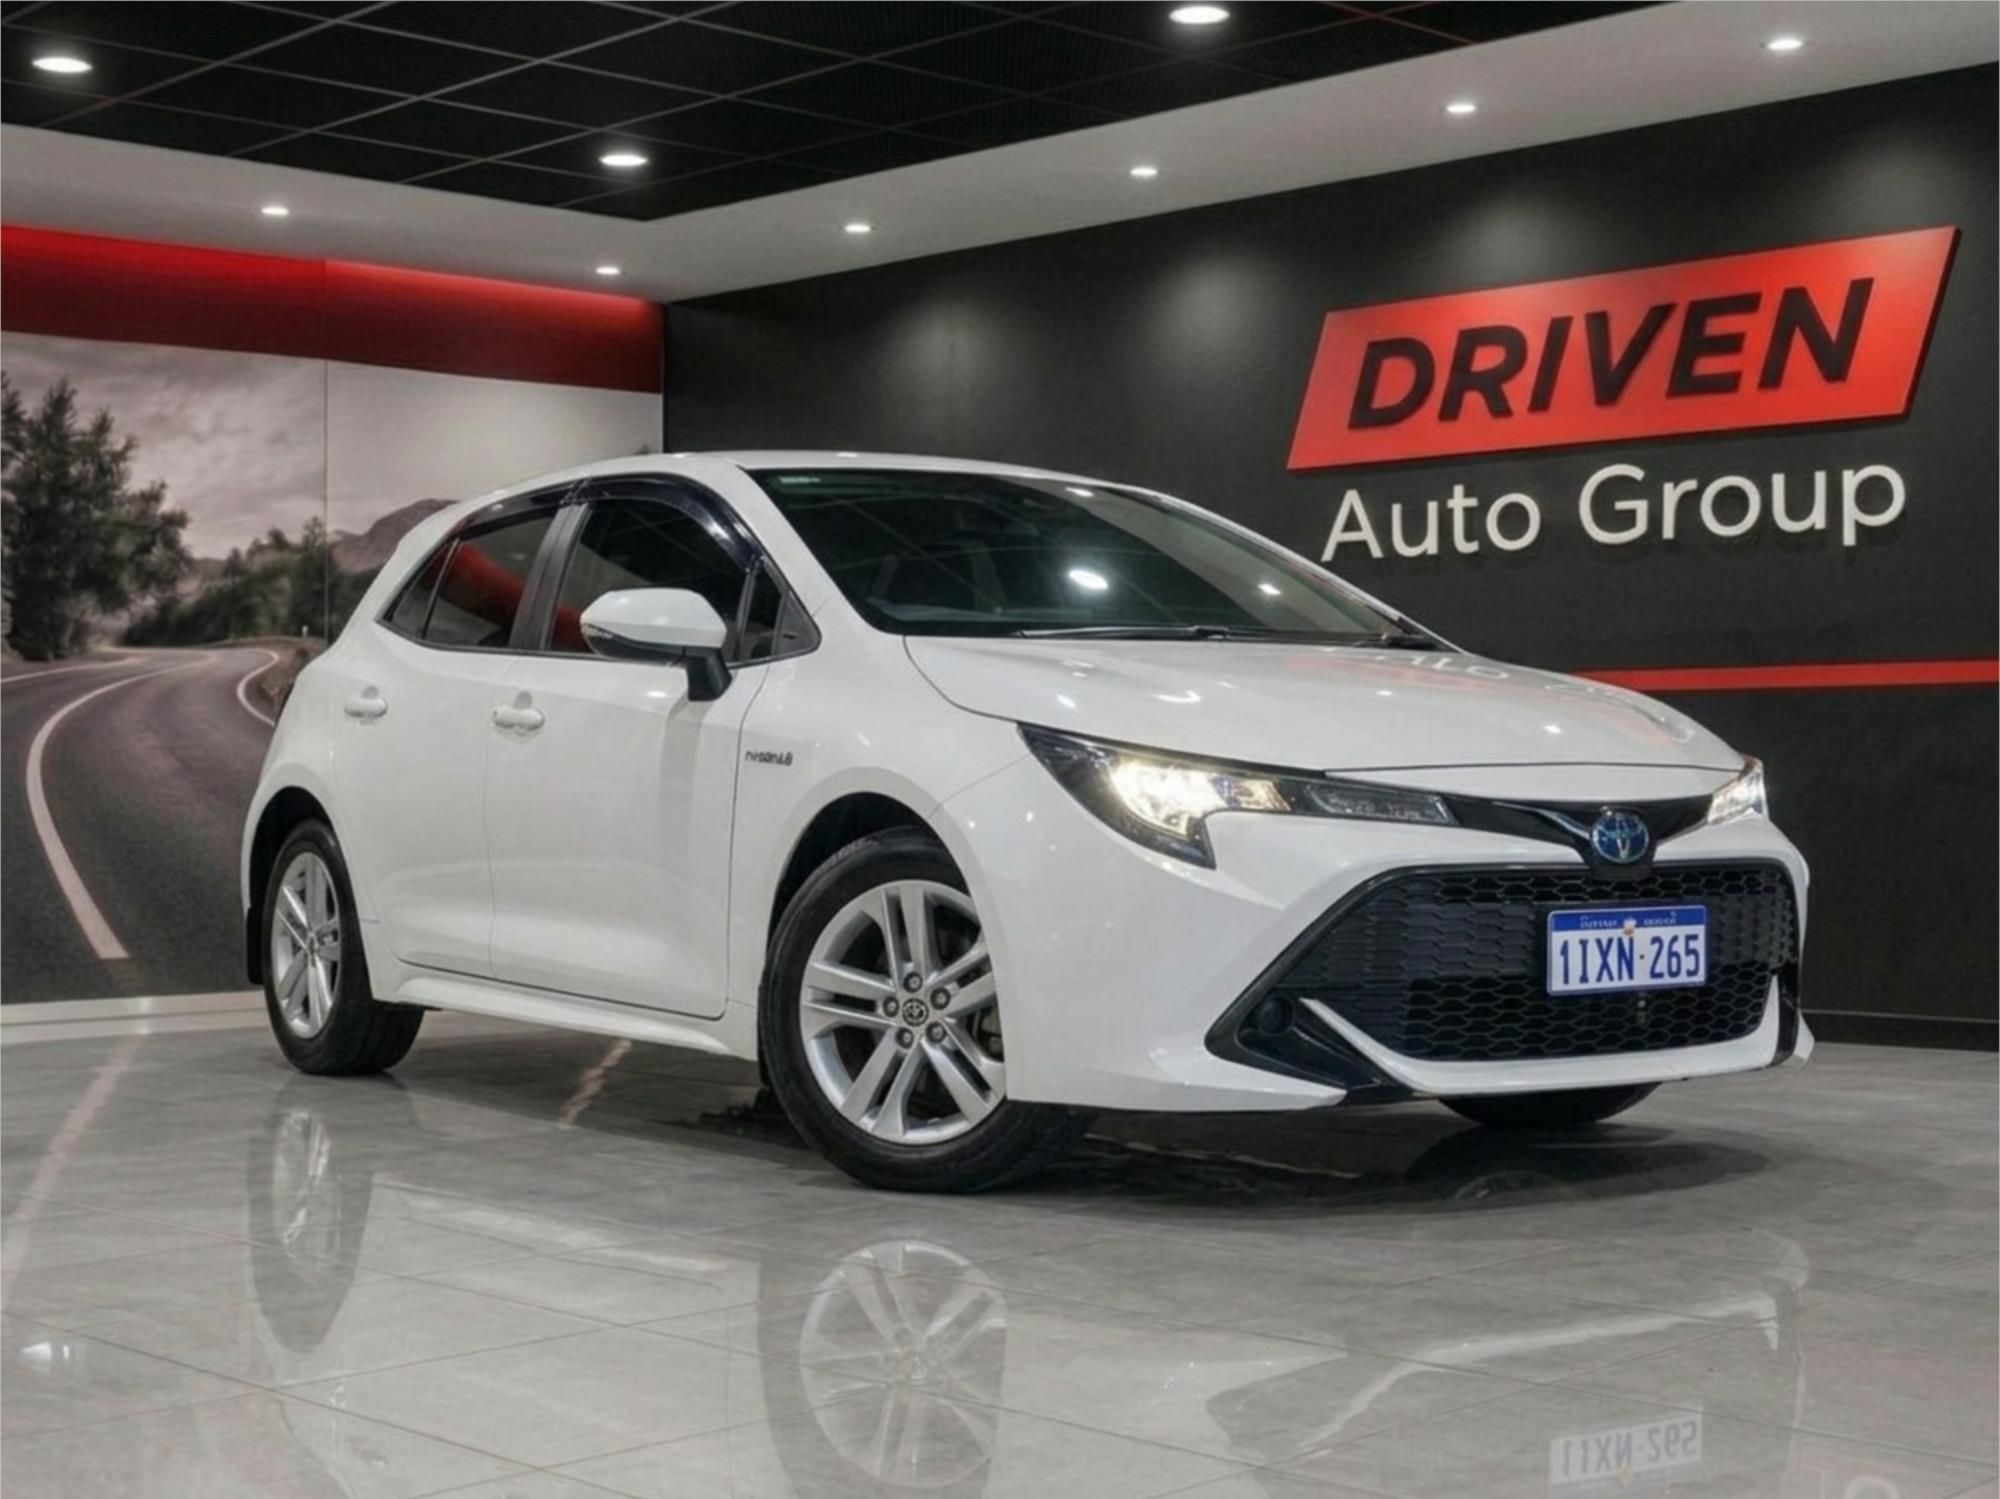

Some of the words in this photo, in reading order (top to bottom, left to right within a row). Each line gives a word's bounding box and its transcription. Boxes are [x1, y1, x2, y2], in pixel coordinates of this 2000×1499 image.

[1347, 277, 1874, 431] DRIVEN
[1321, 484, 1541, 563] Auto
[1579, 460, 1906, 547] Group
